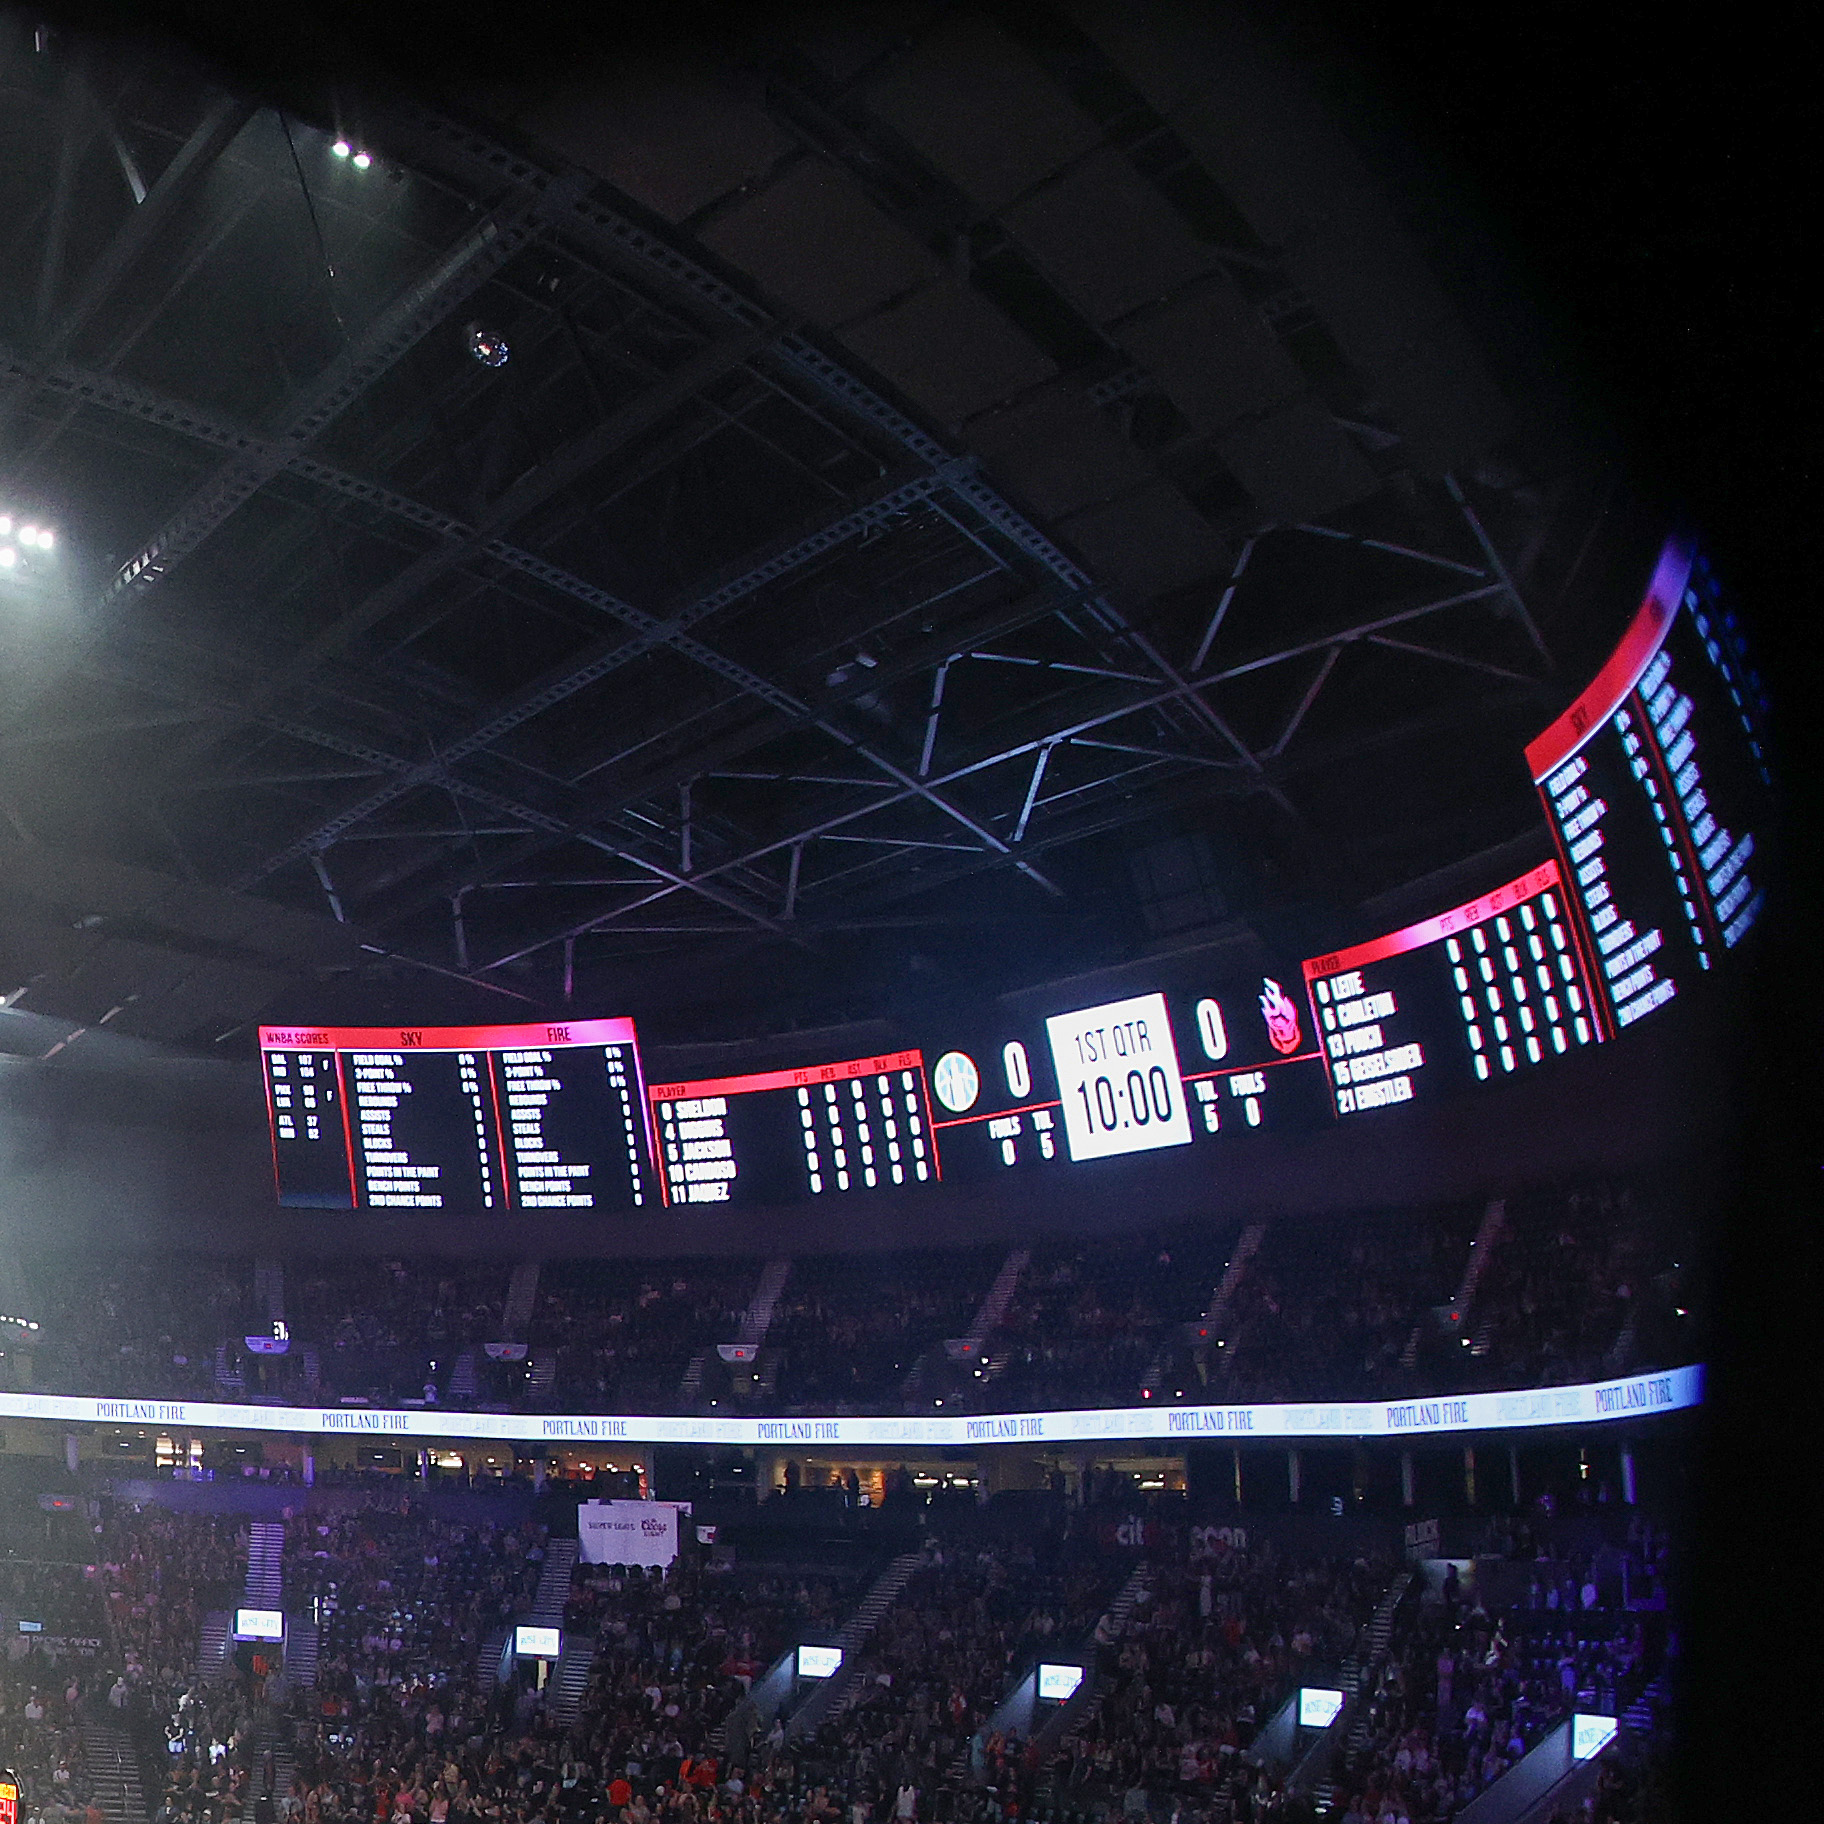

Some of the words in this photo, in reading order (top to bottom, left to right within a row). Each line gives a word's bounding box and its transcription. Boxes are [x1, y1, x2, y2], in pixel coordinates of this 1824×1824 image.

[266, 1032, 293, 1043] WNBA
[295, 1032, 329, 1044] SCORES
[401, 1031, 422, 1046] SKY
[547, 1027, 572, 1042] FIRE
[1196, 997, 1229, 1061] 0
[1074, 1028, 1106, 1064] 1ST
[1112, 1019, 1152, 1058] QTR
[1004, 1040, 1033, 1098] 0
[1077, 1065, 1173, 1134] 10:00
[1336, 1087, 1356, 1114] 21
[1203, 1103, 1221, 1133] 5
[1244, 1096, 1262, 1127] 0
[665, 1122, 676, 1140] 4
[667, 1143, 679, 1162] 5
[1002, 1138, 1017, 1166] 0
[1040, 1132, 1055, 1159] 5
[671, 1185, 687, 1203] 11
[1595, 1383, 1646, 1413] PORTLAND
[1647, 1377, 1673, 1404] FIRE
[96, 1402, 156, 1420] PORTLAND
[158, 1404, 186, 1420] FIRE
[321, 1412, 379, 1430] PORTLAND
[382, 1414, 410, 1430] FIRE
[1168, 1411, 1225, 1431] PORTLAND
[1227, 1410, 1254, 1430] FIRE
[1386, 1403, 1440, 1428] PORTLAND
[1442, 1401, 1469, 1424] FIRE
[543, 1420, 599, 1437] PORTLAND
[601, 1420, 628, 1436] FIRE
[758, 1422, 813, 1439] PORTLAND
[815, 1422, 840, 1439] FIRE
[966, 1420, 1017, 1438] PORTLAND
[1020, 1418, 1044, 1436] FIRE
